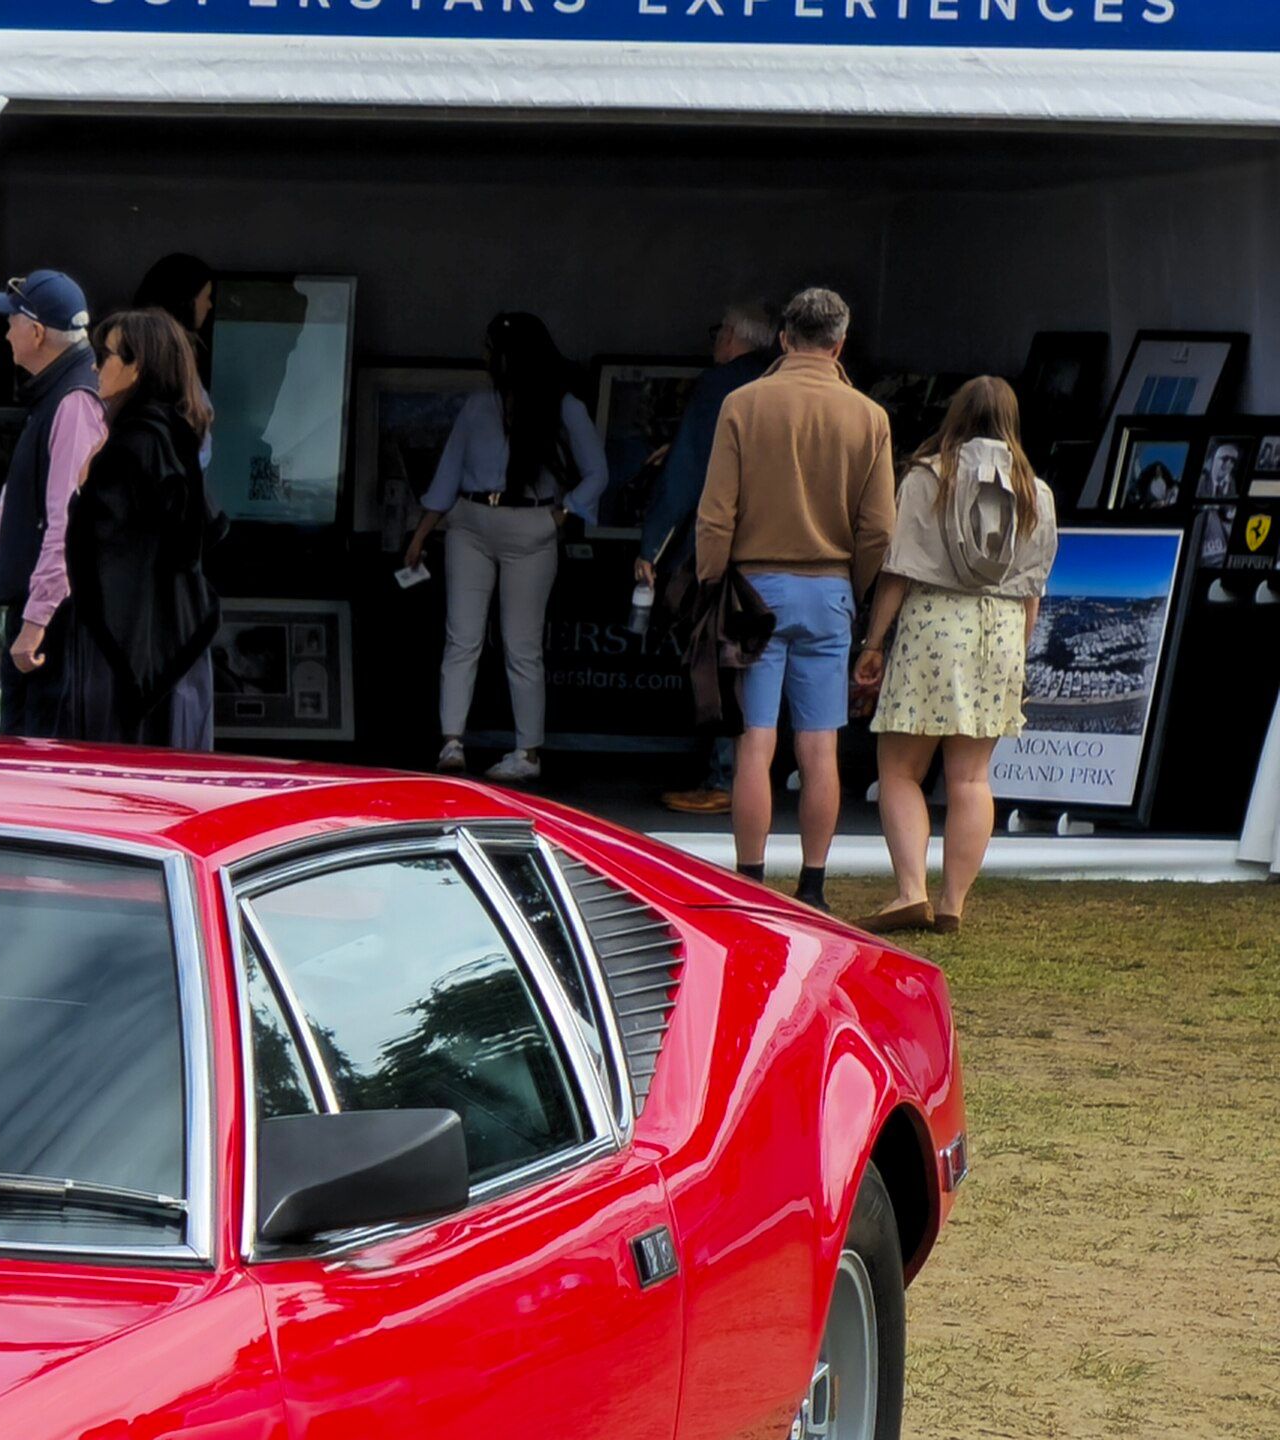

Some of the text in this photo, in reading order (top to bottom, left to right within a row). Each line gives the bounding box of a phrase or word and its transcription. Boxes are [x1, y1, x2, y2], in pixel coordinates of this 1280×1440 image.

[544, 667, 683, 692] erstars.com
[1013, 737, 1104, 758] MONACO
[993, 762, 1117, 786] GRAND PRIX
